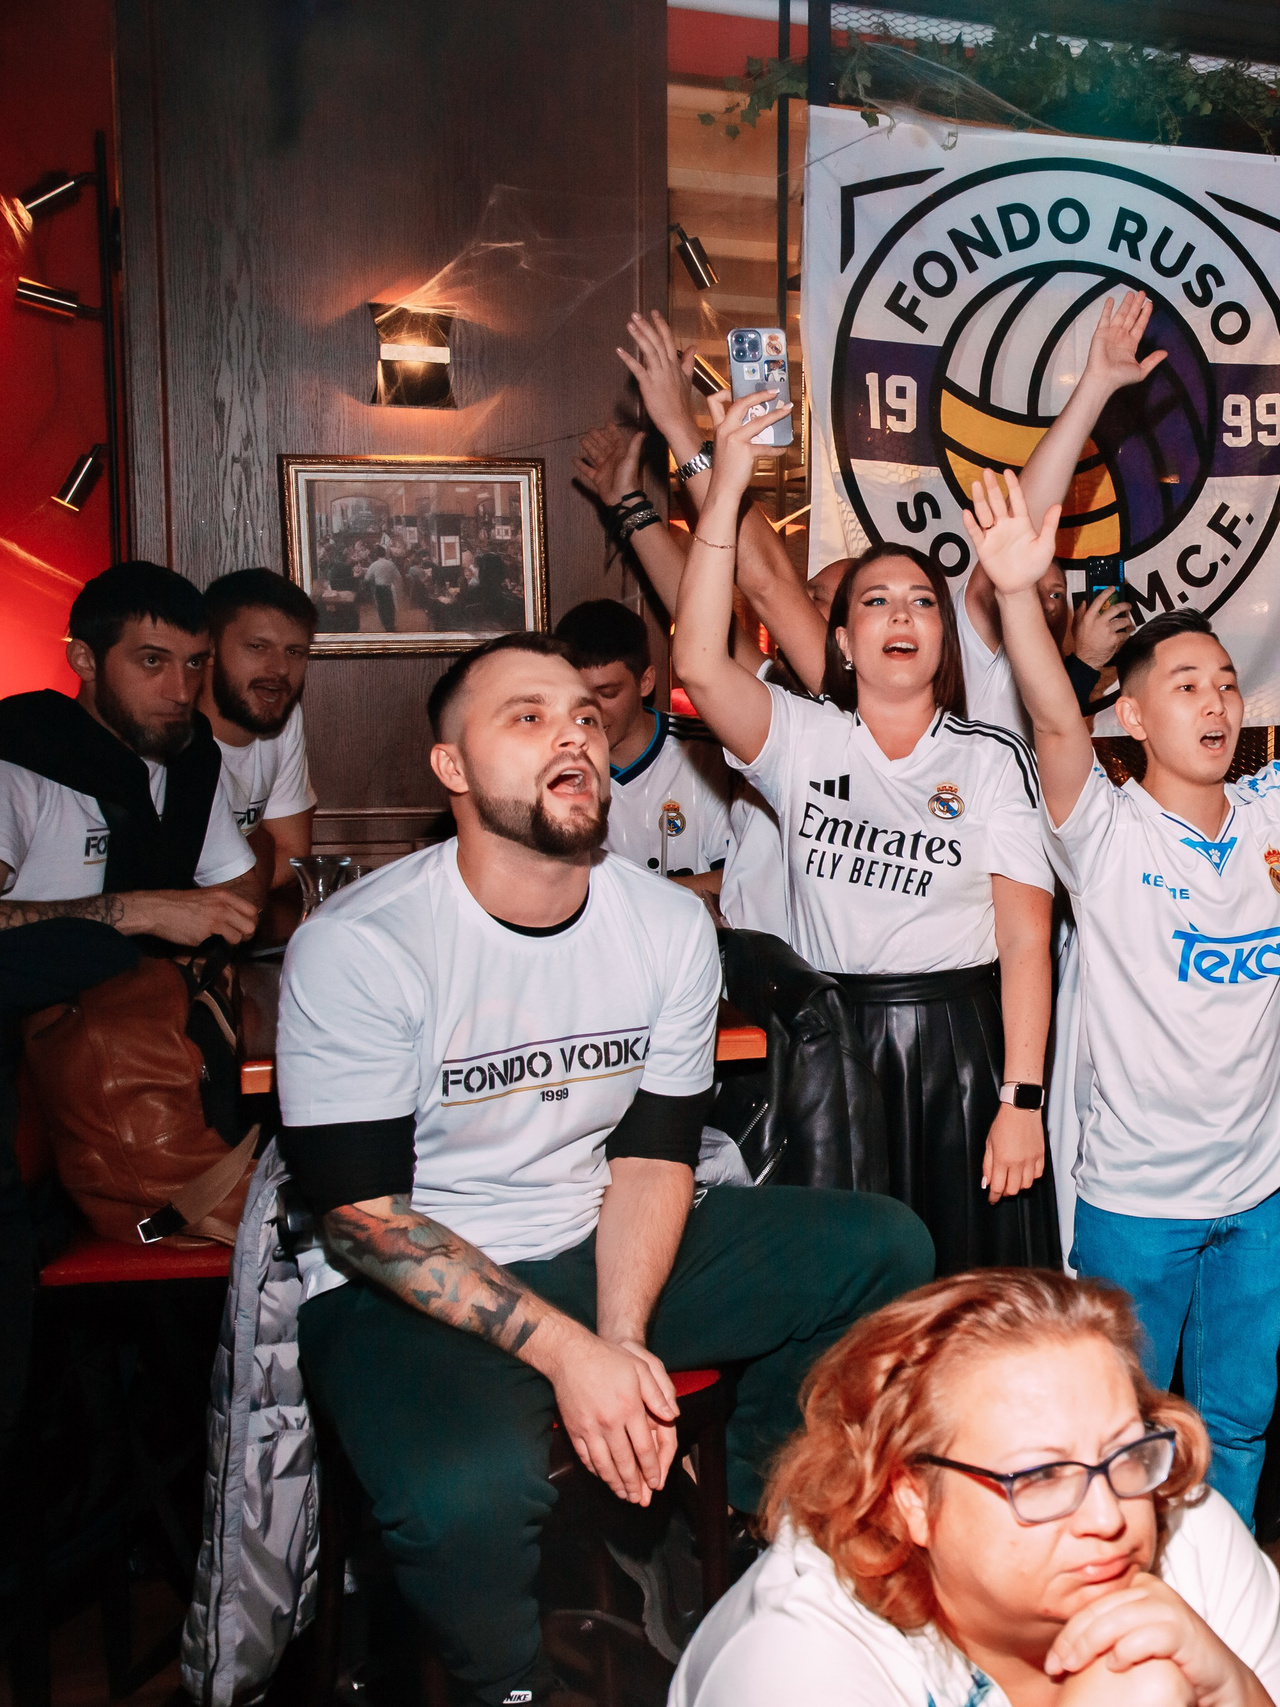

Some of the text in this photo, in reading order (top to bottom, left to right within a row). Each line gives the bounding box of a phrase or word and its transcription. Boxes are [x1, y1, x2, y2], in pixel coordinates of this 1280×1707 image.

[883, 197, 1252, 346] FONDO RUSO
[865, 372, 918, 433] 19
[798, 802, 962, 867] Emirates
[805, 848, 933, 898] FLY BETTER
[442, 1051, 553, 1097] FONDO
[540, 1087, 569, 1103] 1999
